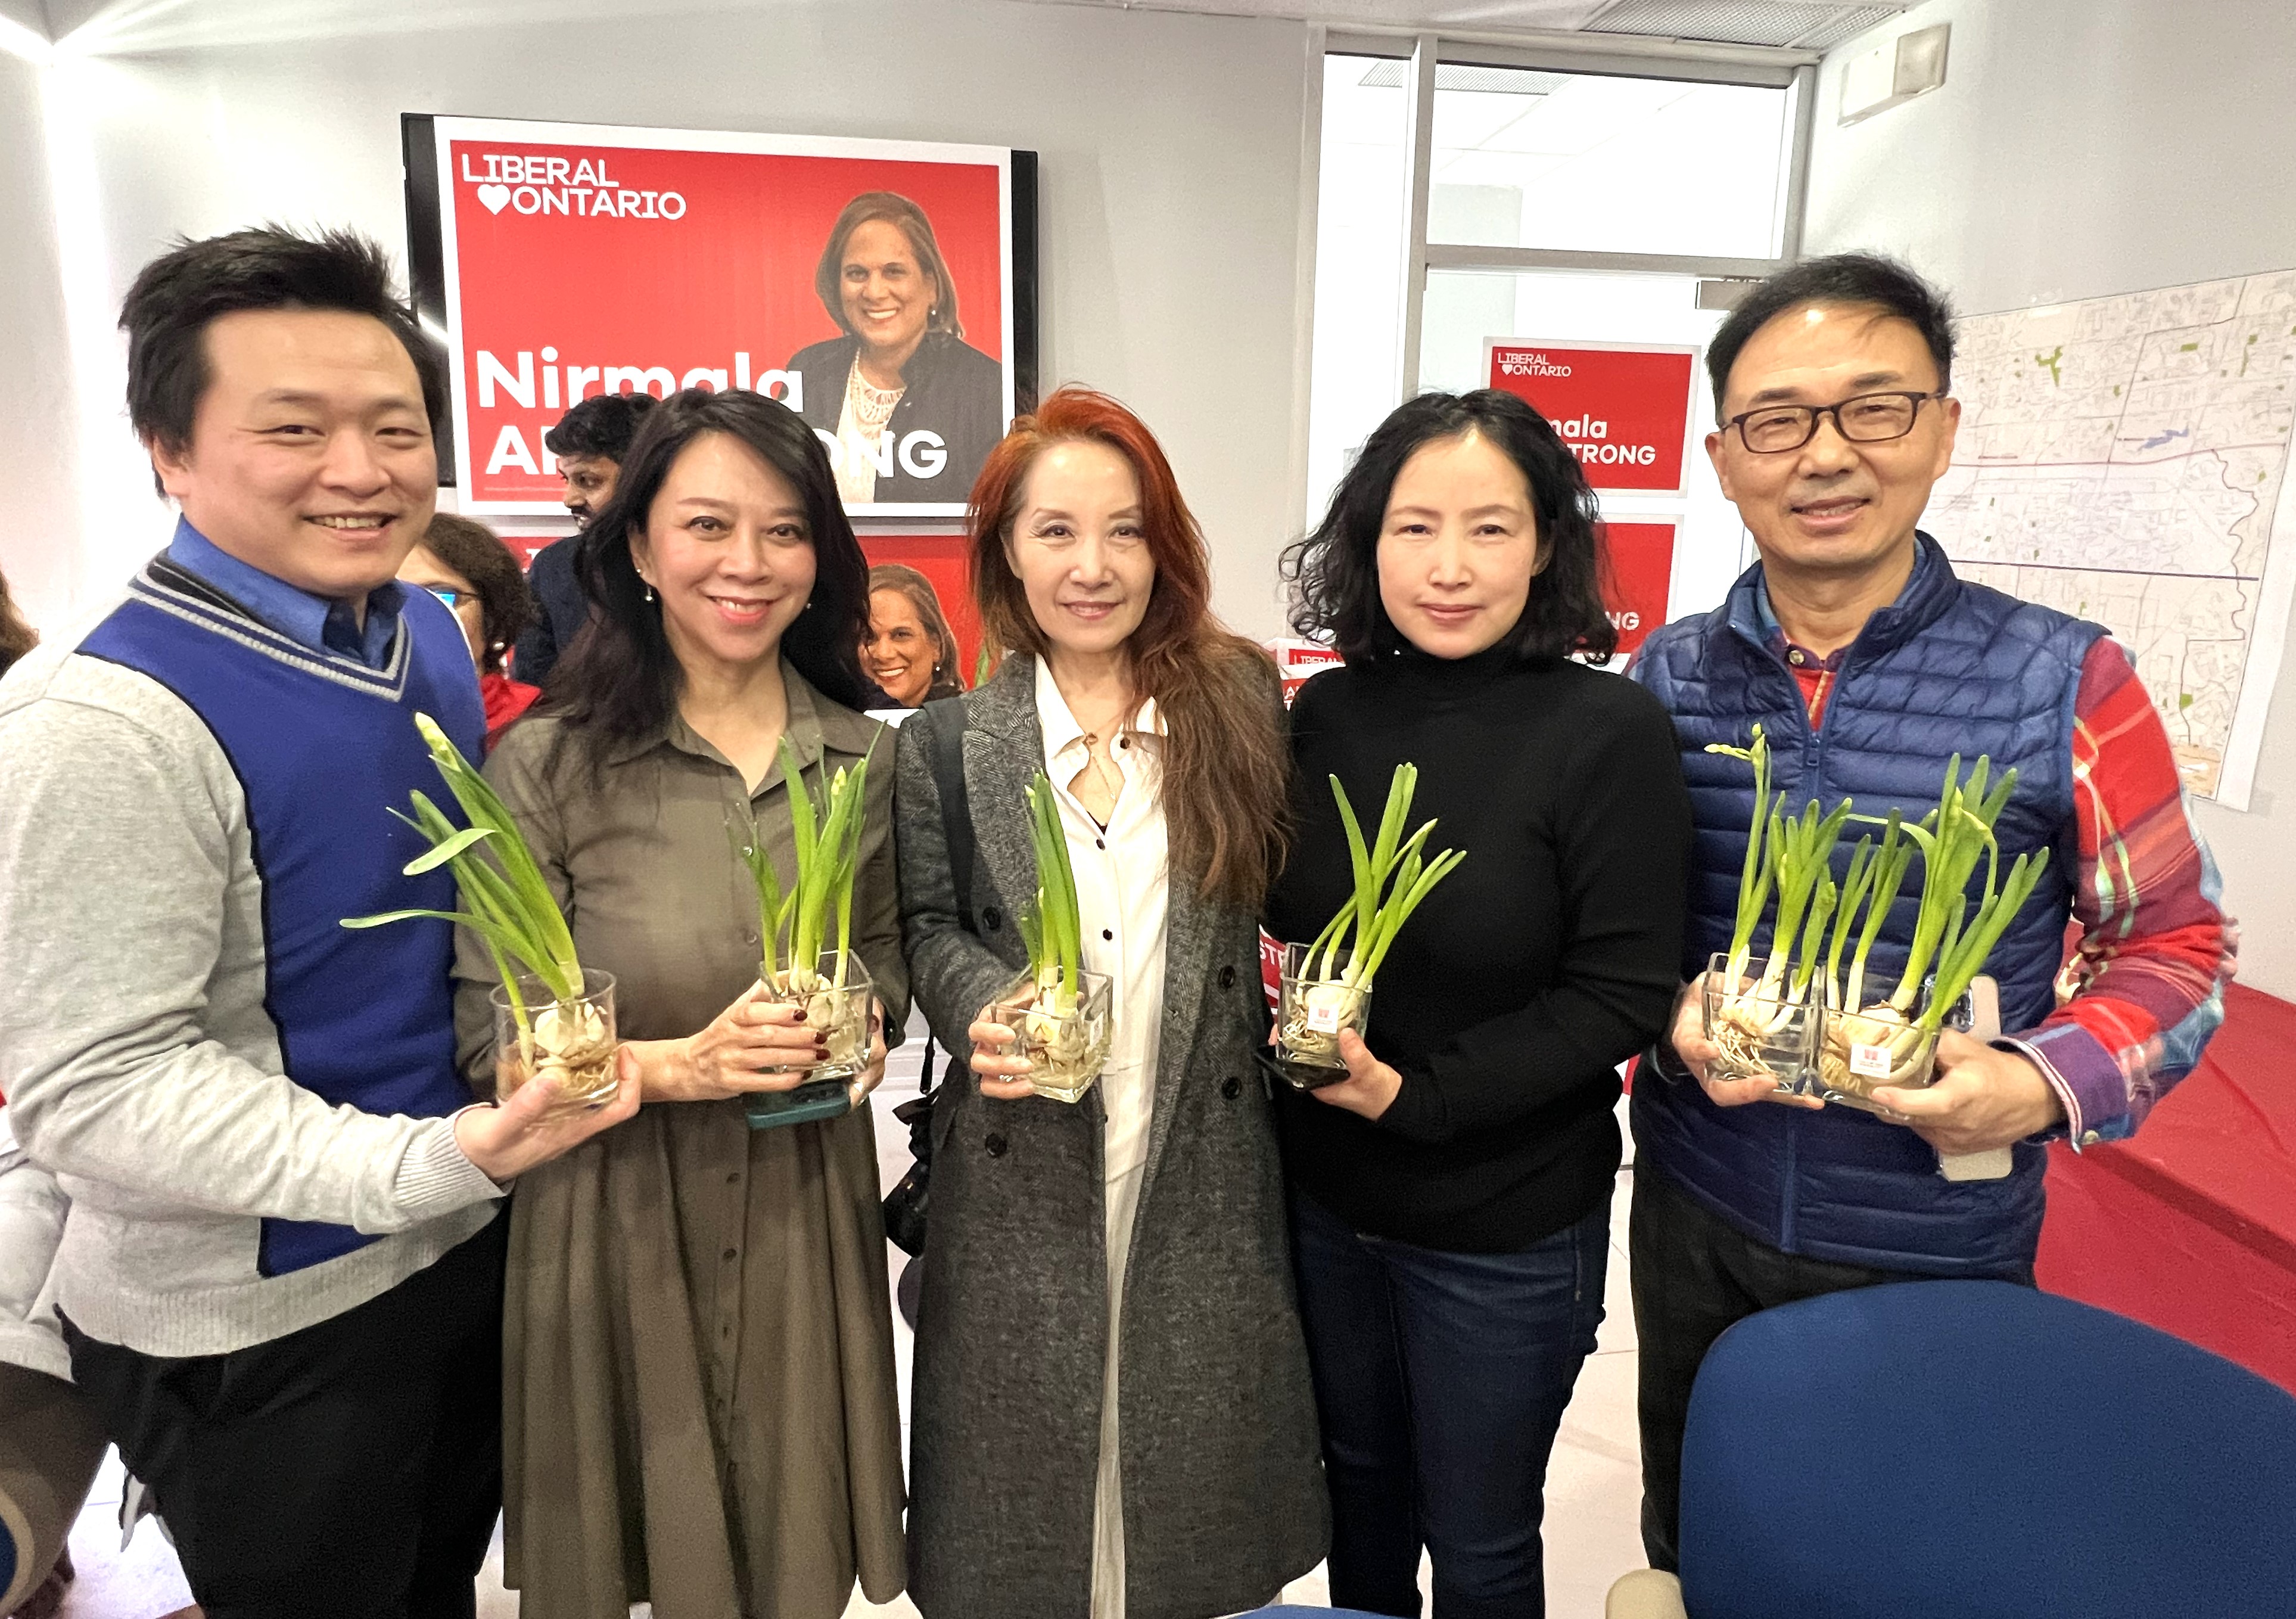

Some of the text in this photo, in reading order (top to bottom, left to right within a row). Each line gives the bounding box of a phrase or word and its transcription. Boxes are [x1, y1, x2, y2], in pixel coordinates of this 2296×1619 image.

[462, 153, 620, 188] LIBERAL
[512, 185, 687, 220] ONTARIO
[1497, 352, 1550, 365] LIBERAL
[1513, 364, 1572, 377] ONTARIO
[1566, 443, 1656, 465] TRONG
